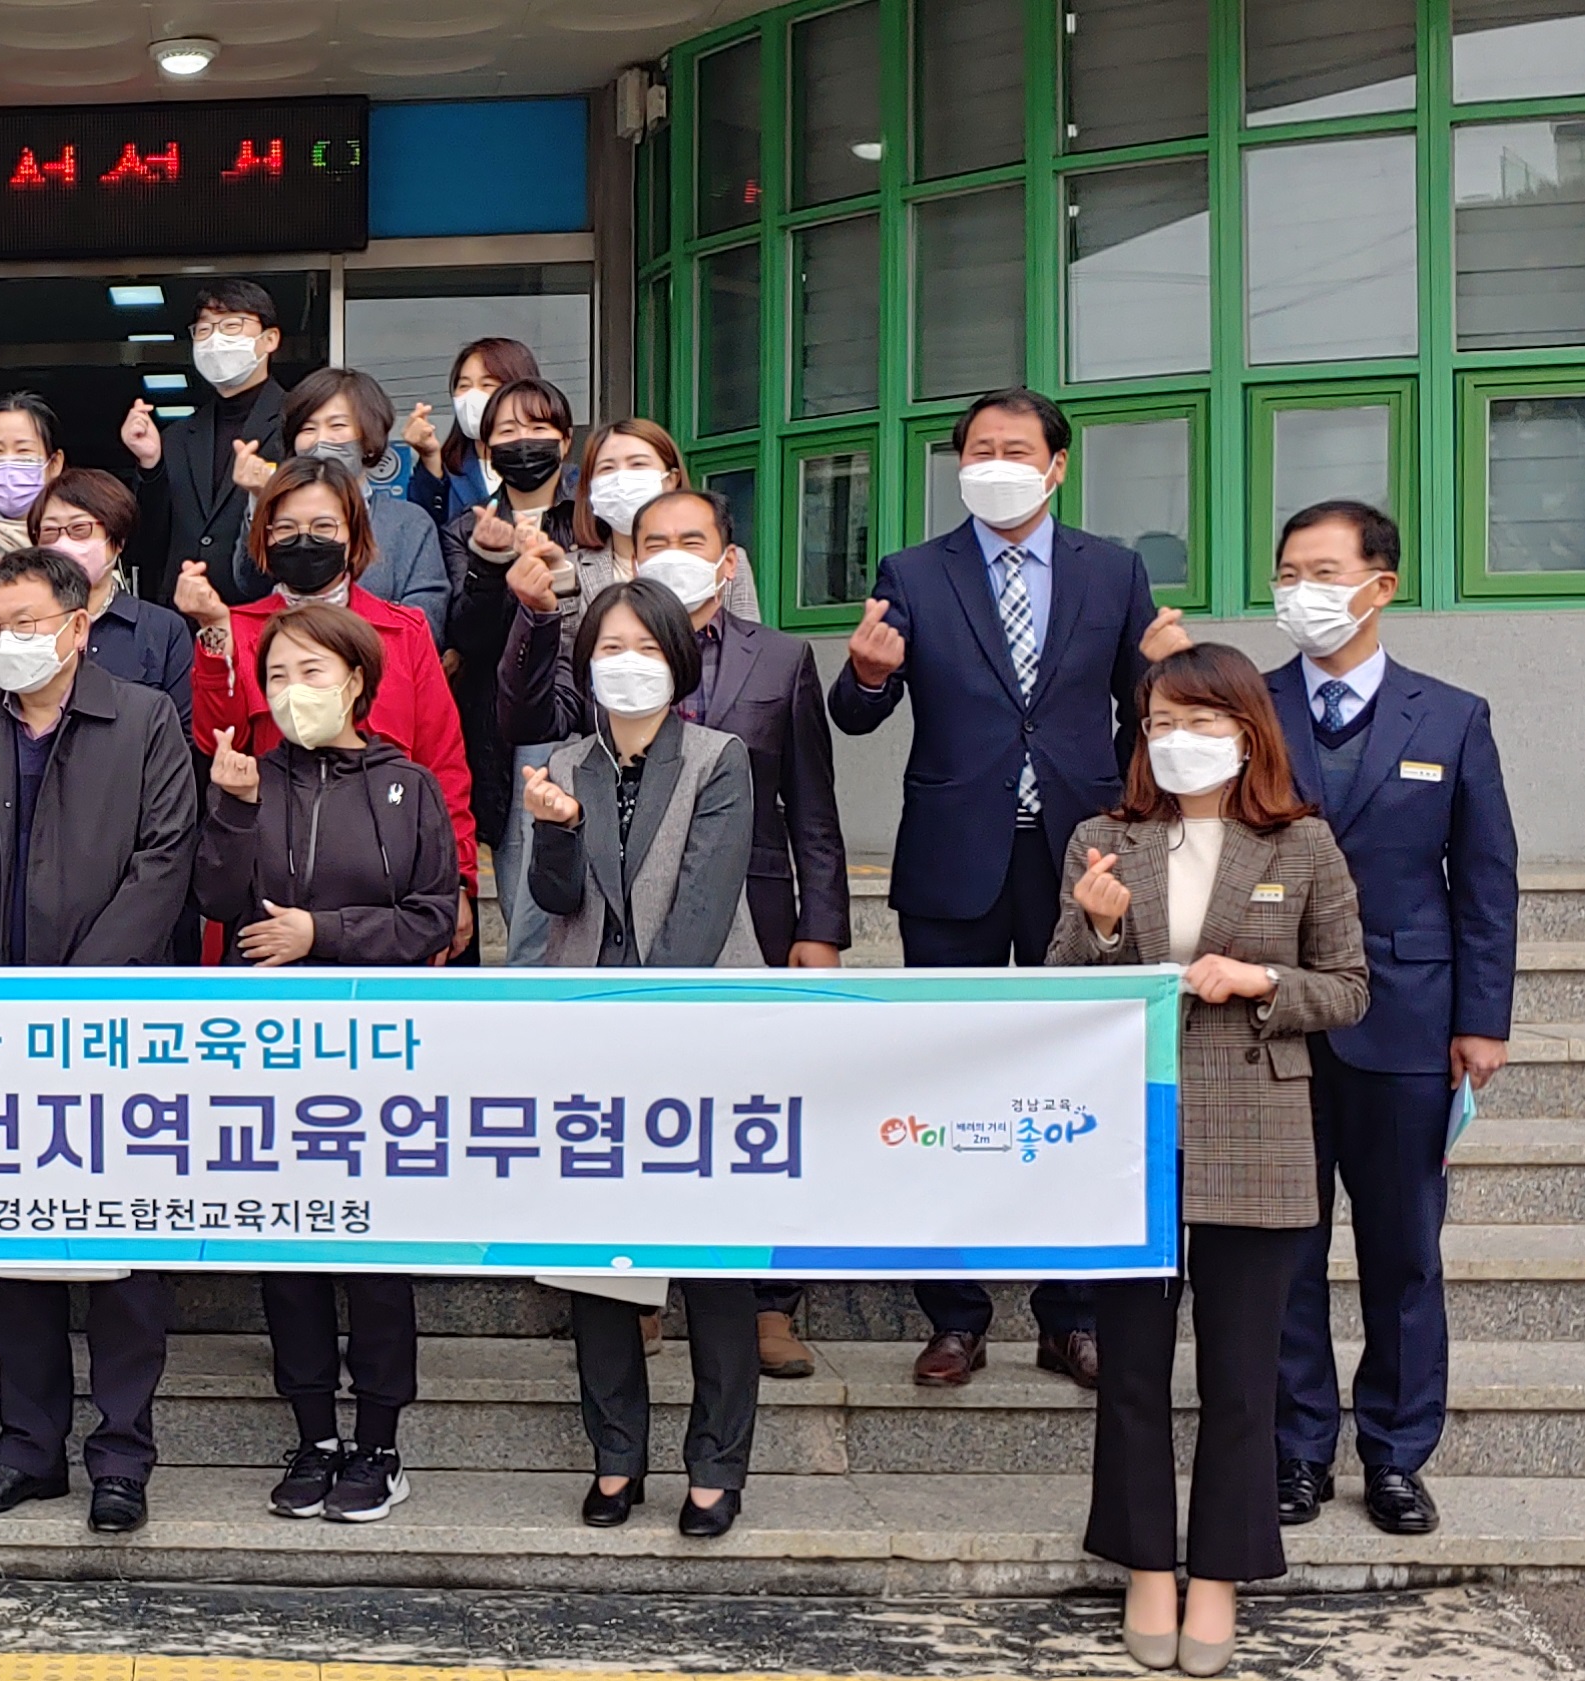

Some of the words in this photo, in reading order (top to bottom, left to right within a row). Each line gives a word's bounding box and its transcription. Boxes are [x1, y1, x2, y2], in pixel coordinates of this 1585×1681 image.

[27, 1017, 421, 1071] 미래교육입니다
[1010, 1099, 1073, 1113] 경남교육
[972, 1134, 991, 1145] 2m
[1016, 1112, 1098, 1163] 좋아
